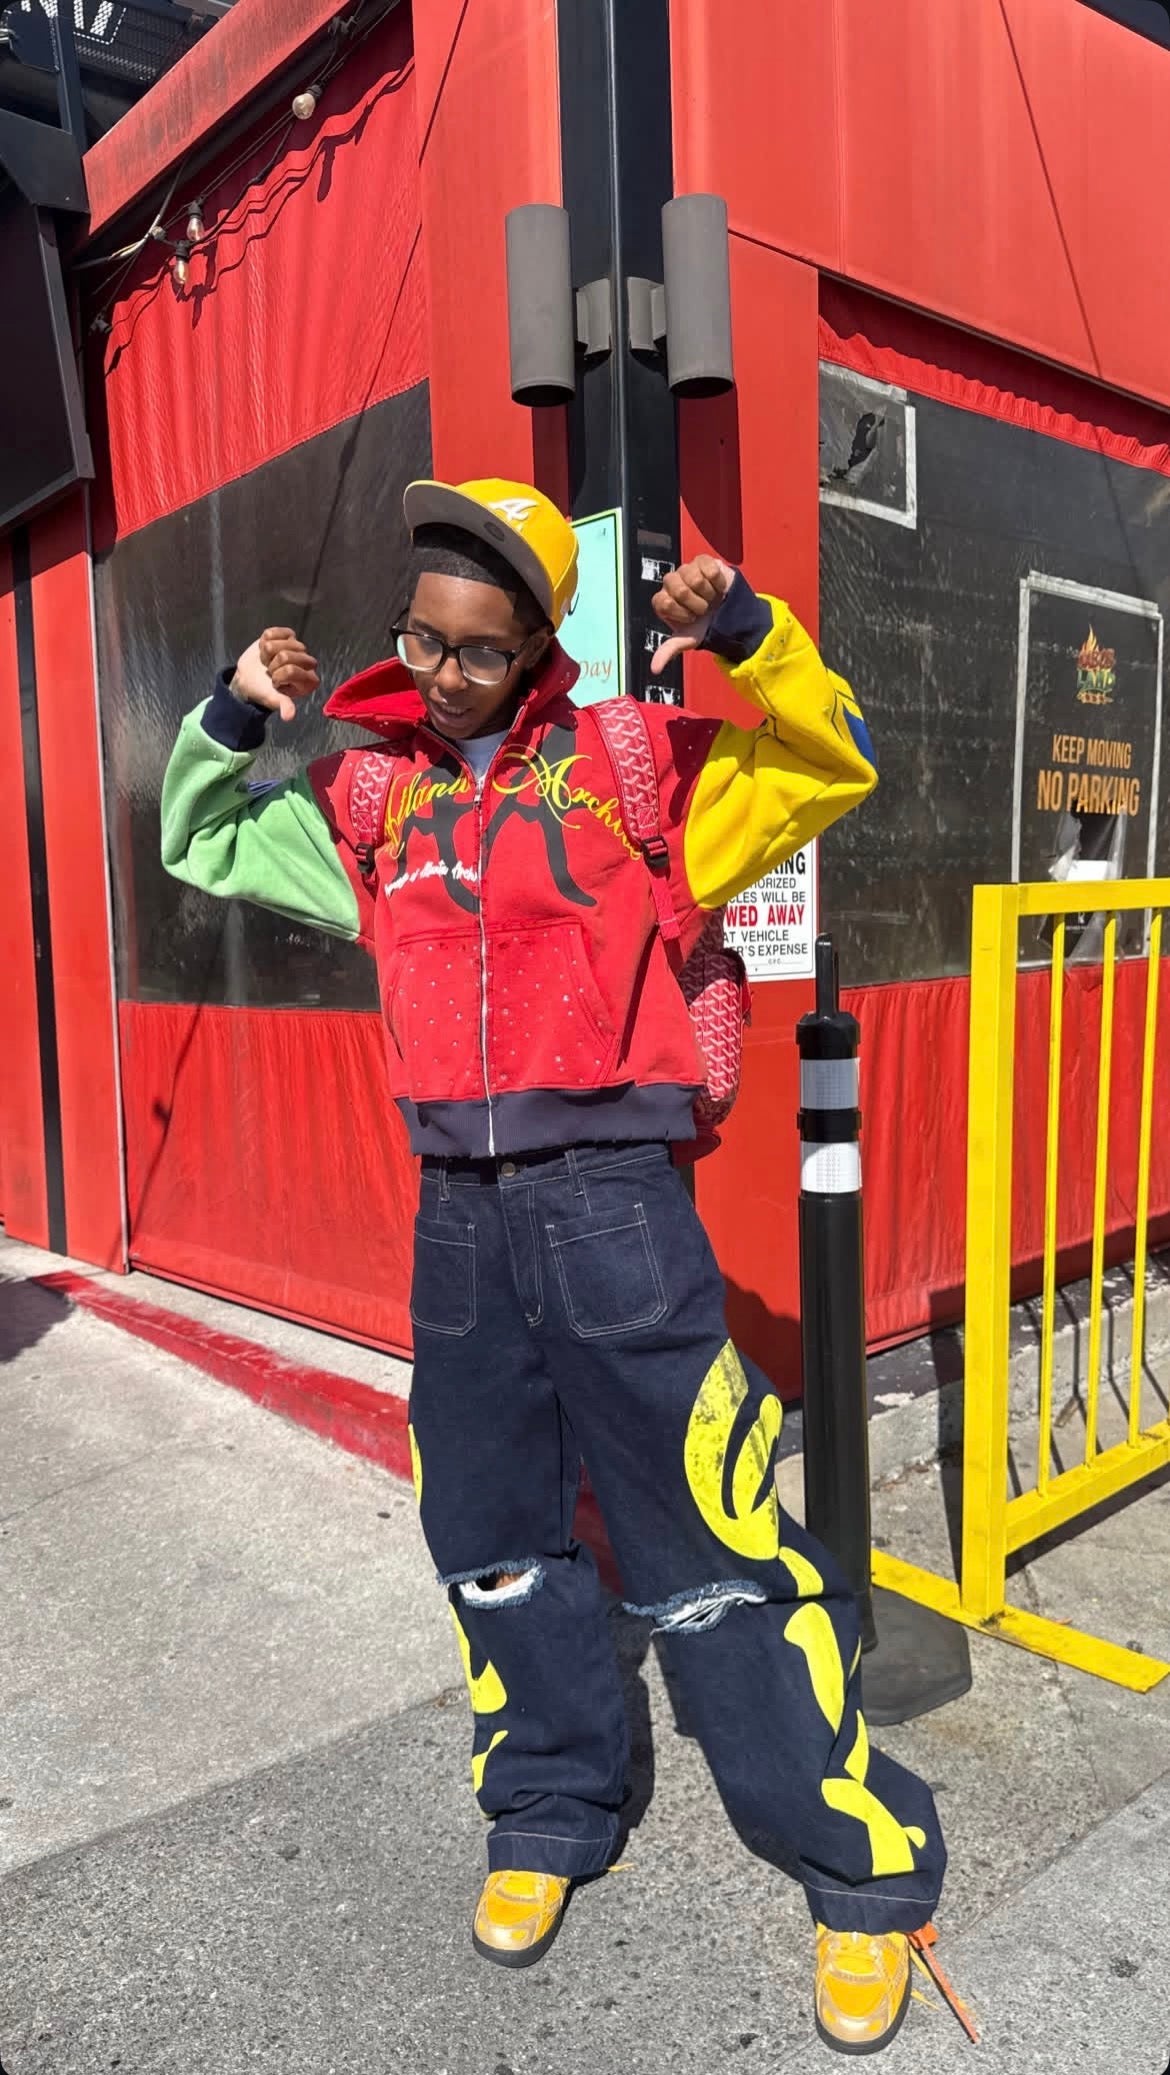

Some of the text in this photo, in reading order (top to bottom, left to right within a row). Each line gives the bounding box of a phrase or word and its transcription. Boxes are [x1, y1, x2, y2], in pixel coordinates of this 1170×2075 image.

[1052, 734, 1132, 769] KEEP MOVING
[1037, 769, 1140, 817] NO PARKING
[761, 891, 788, 903] WILL
[792, 891, 806, 902] BE
[768, 904, 805, 926] AWAY
[741, 930, 790, 942] VEHICLE
[758, 943, 809, 957] EXPENSE
